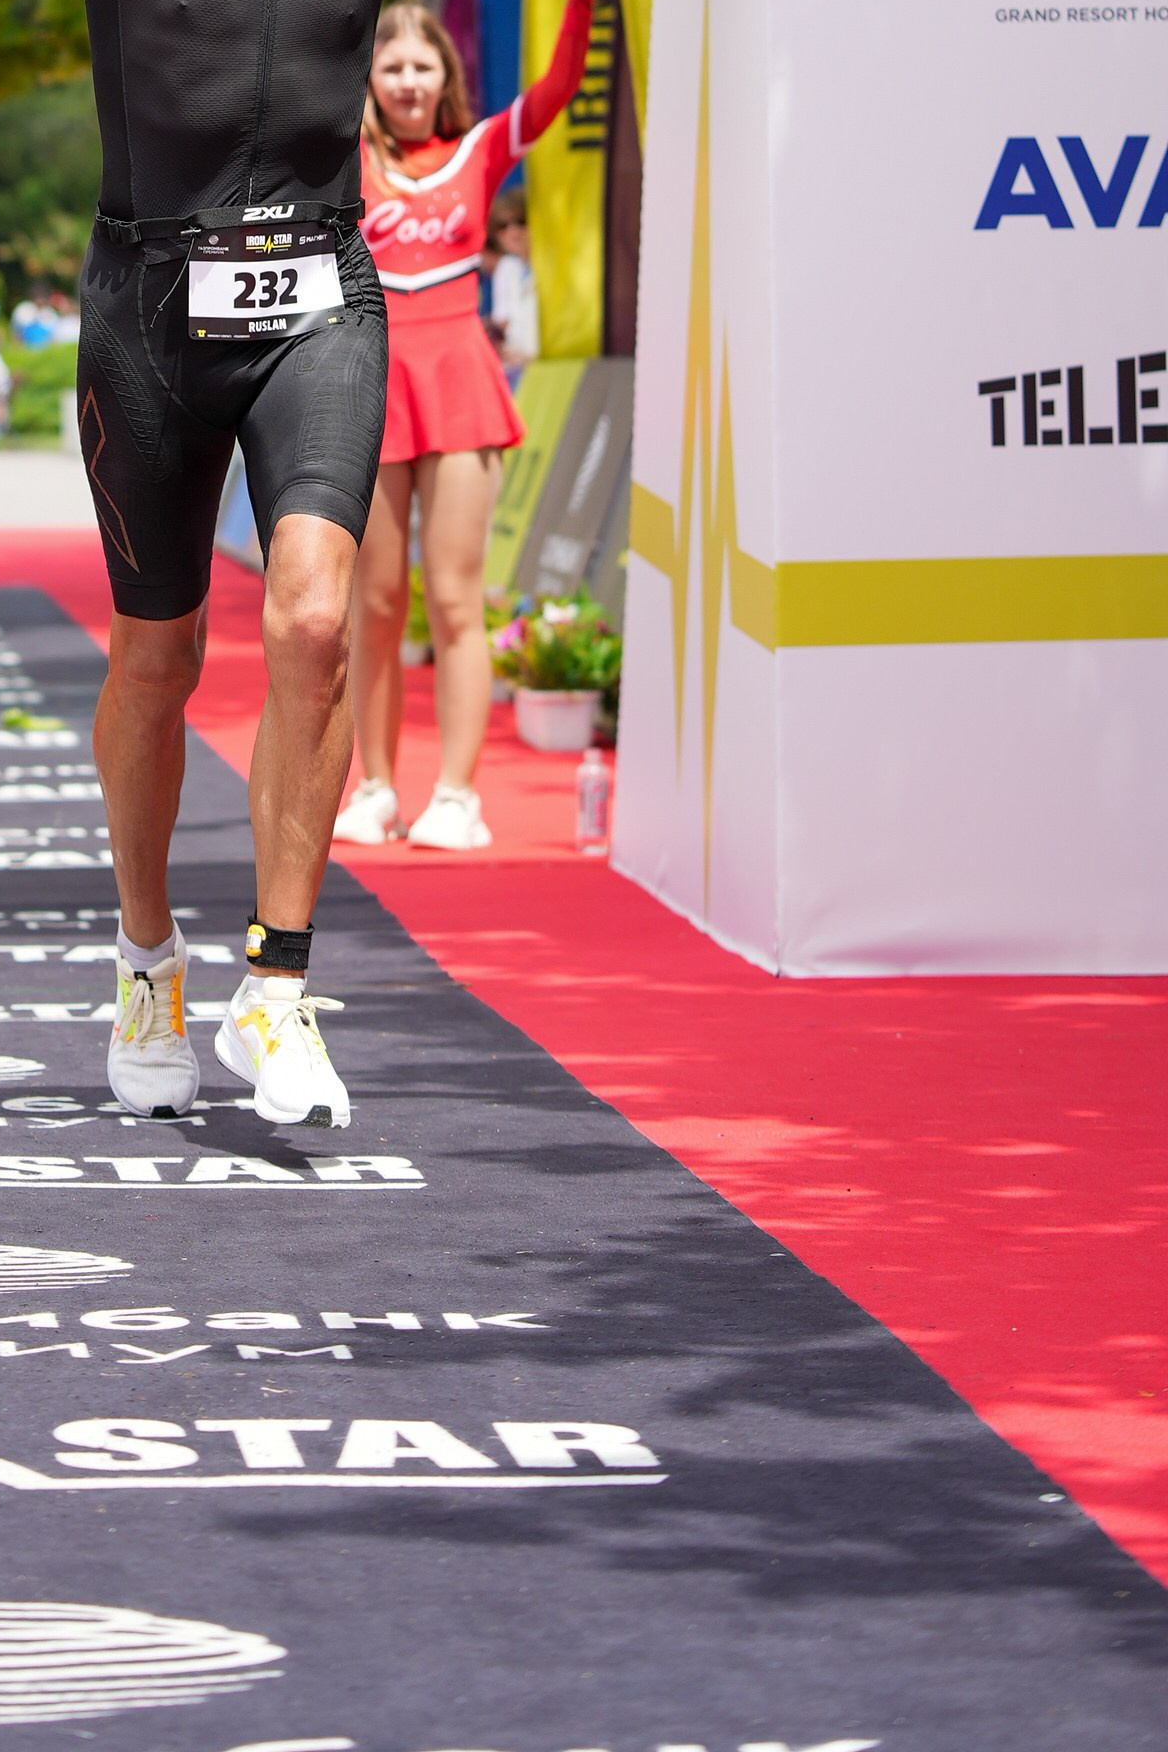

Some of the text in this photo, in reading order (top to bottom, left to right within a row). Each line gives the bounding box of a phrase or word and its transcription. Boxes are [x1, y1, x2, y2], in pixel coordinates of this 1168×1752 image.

[995, 8, 1062, 24] GRAND
[1066, 7, 1138, 22] RESORT
[242, 204, 295, 222] 2XU
[358, 199, 468, 253] Cool
[246, 233, 293, 246] IRON STAR
[233, 268, 298, 309] 232
[248, 318, 288, 333] RUSLAN
[52, 1418, 661, 1471] STAR
